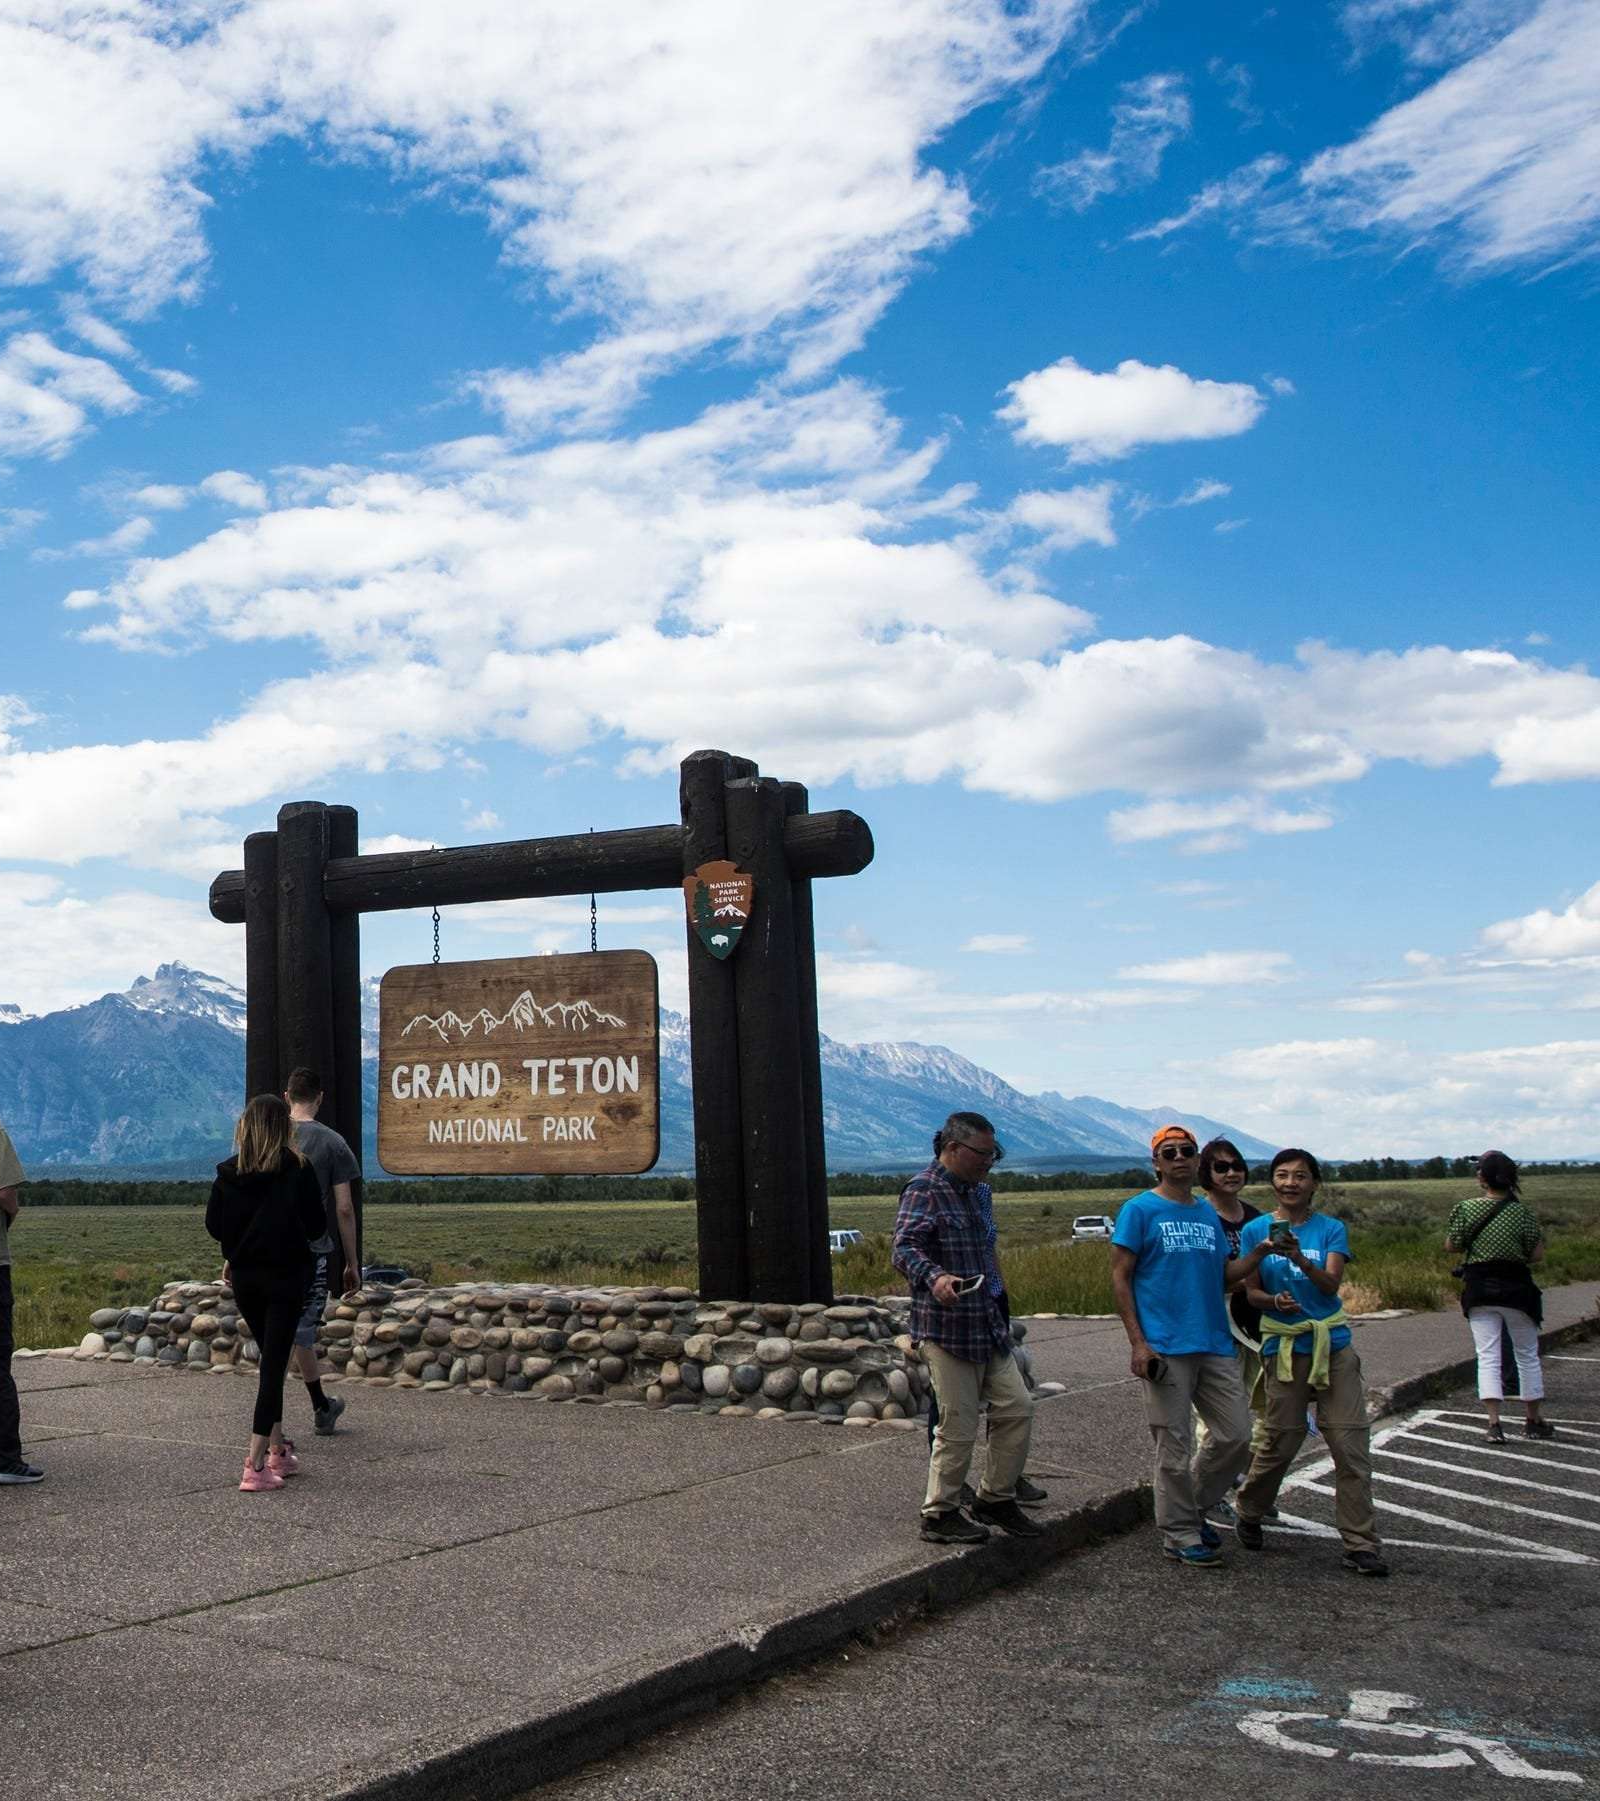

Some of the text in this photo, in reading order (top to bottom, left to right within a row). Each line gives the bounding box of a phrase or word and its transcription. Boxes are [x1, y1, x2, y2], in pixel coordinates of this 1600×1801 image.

[709, 880, 748, 890] NATIONAL
[714, 895, 745, 904] SERVICE
[391, 1055, 640, 1099] GRAND TETON
[429, 1116, 597, 1143] NATIONAL PARK
